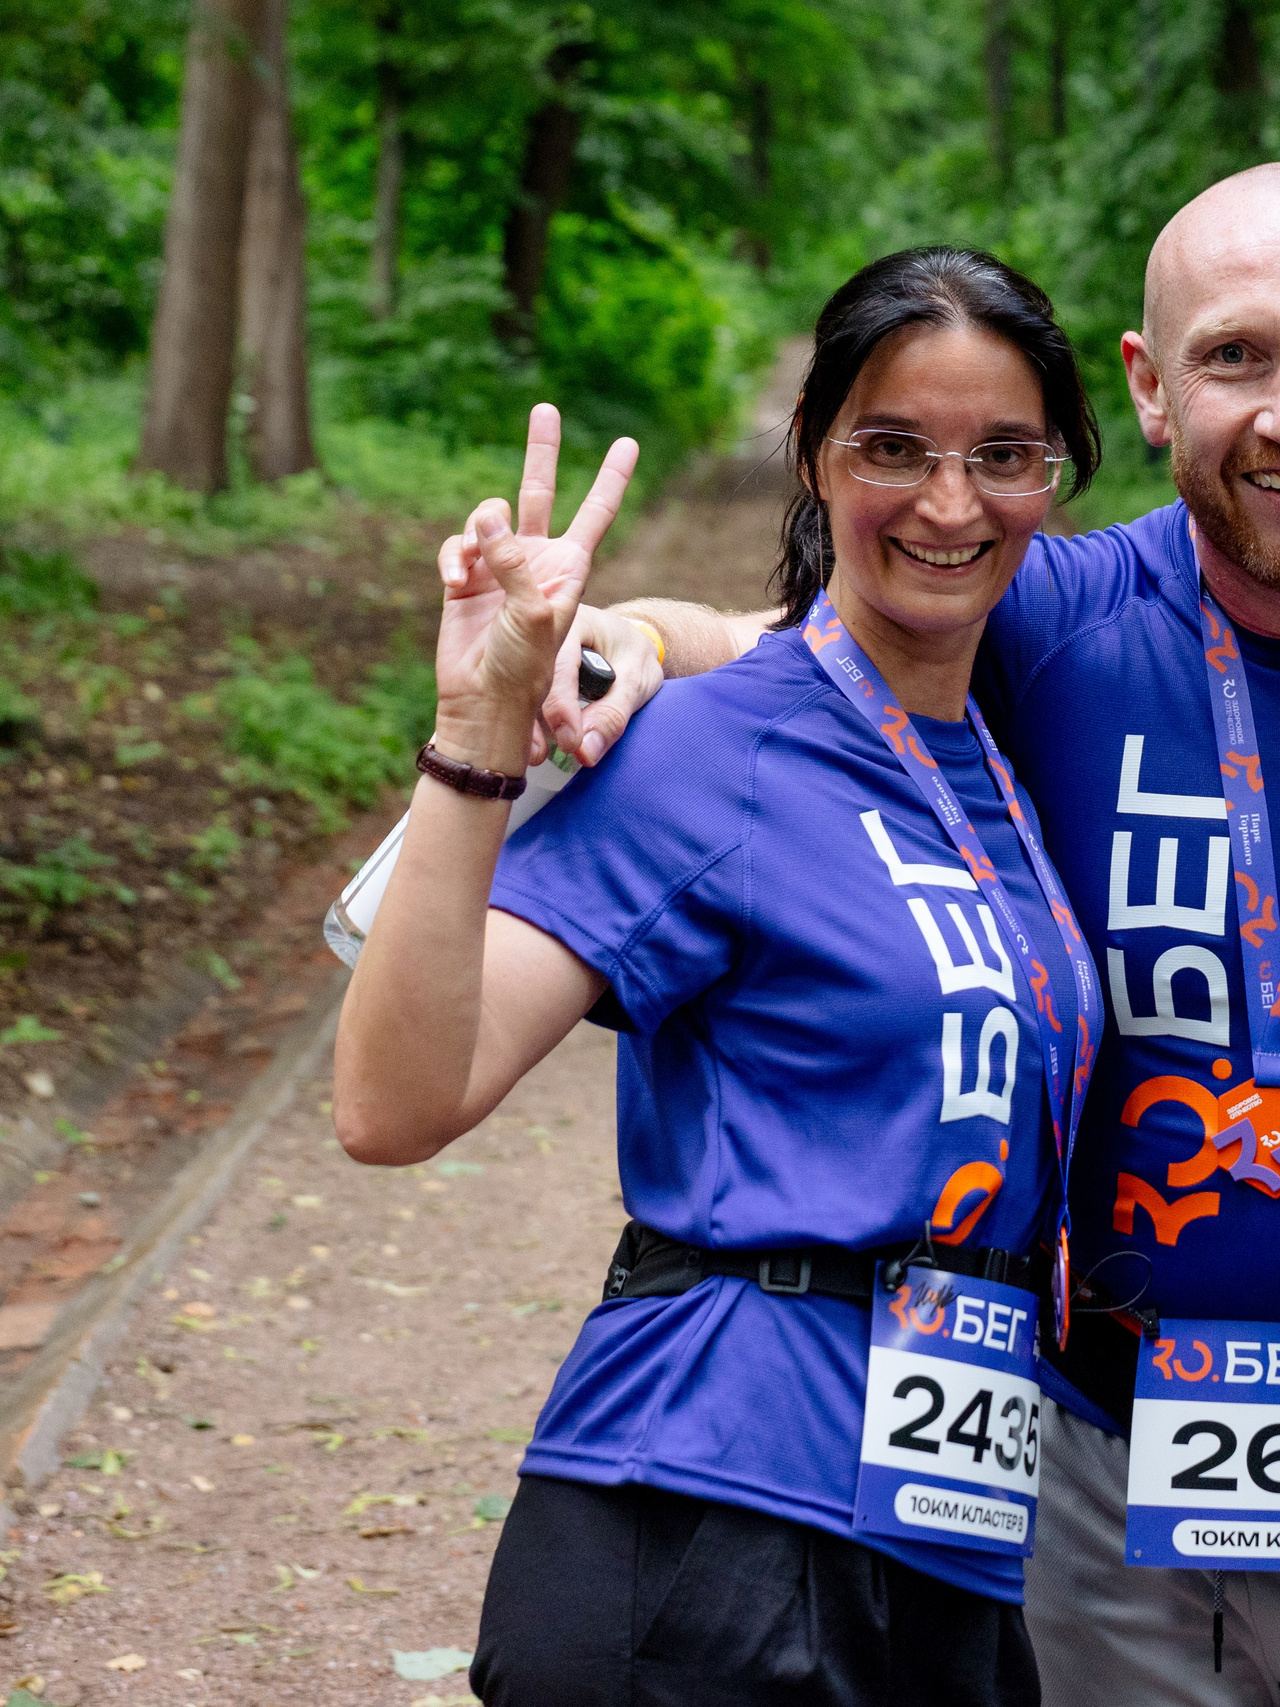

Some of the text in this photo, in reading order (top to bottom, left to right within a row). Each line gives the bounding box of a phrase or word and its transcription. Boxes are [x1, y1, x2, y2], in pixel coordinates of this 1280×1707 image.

[835, 656, 865, 683] БЕГ
[931, 776, 962, 825] Горького
[935, 797, 956, 827] Парк
[1238, 814, 1252, 866] Горького
[1250, 812, 1262, 844] Парк
[888, 1375, 1040, 1477] 2435
[910, 1495, 959, 1520] 10КМ
[961, 1504, 1017, 1530] КЛАСТЕР
[1190, 1529, 1261, 1548] 10КМ
